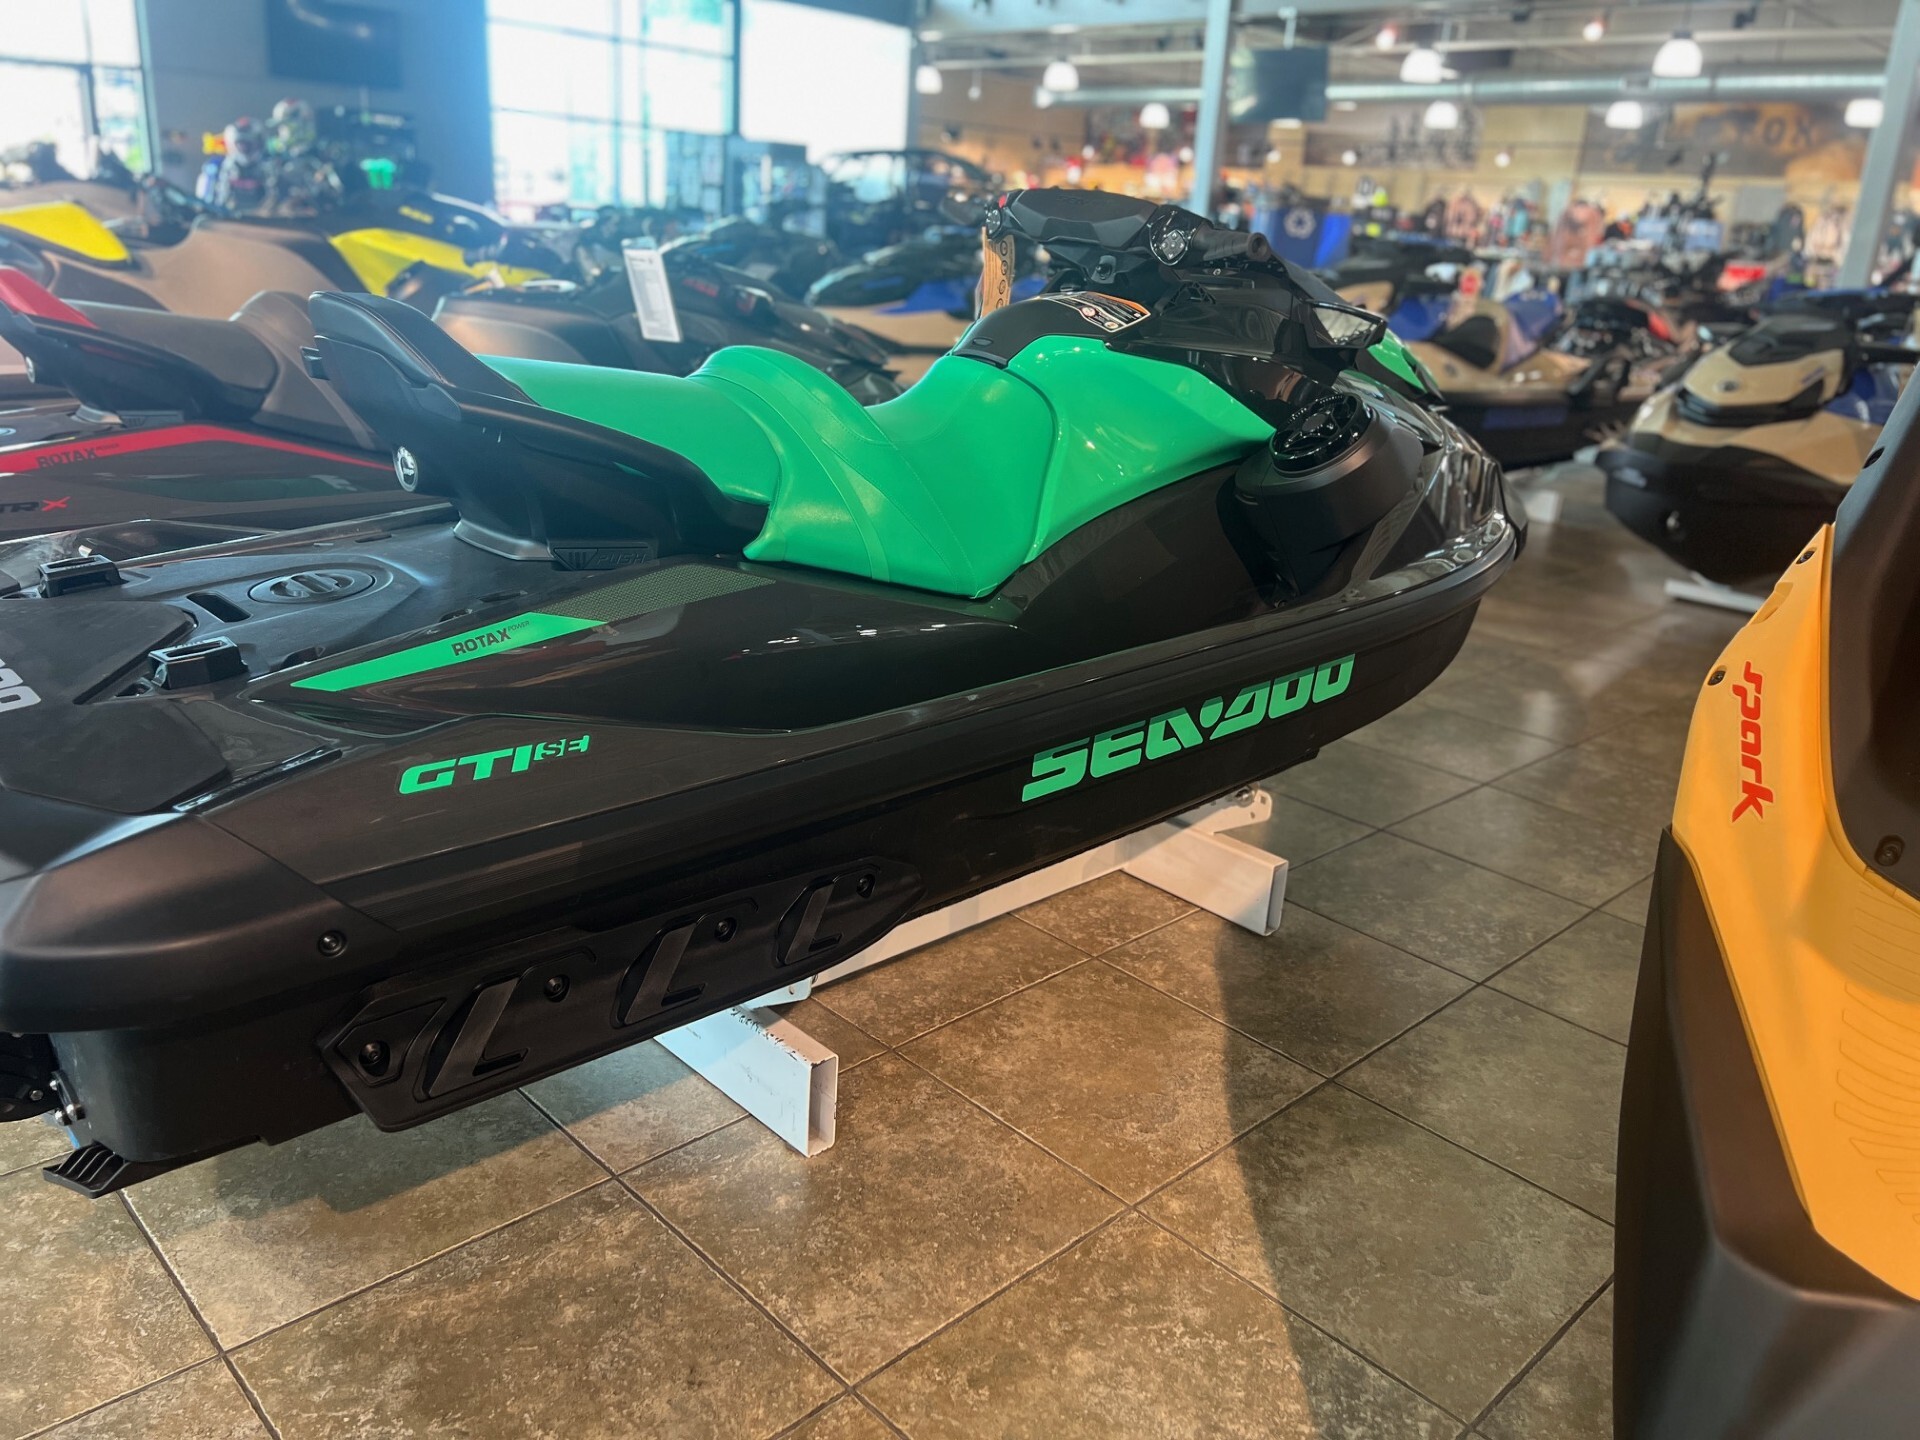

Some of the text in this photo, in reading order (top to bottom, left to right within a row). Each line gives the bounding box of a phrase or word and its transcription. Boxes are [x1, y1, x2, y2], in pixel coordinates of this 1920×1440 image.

[36, 448, 98, 469] ROTAX
[596, 552, 648, 566] PUSH
[451, 620, 530, 657] ROTAX POWER
[1732, 660, 1774, 823] spark
[399, 744, 533, 795] GTI
